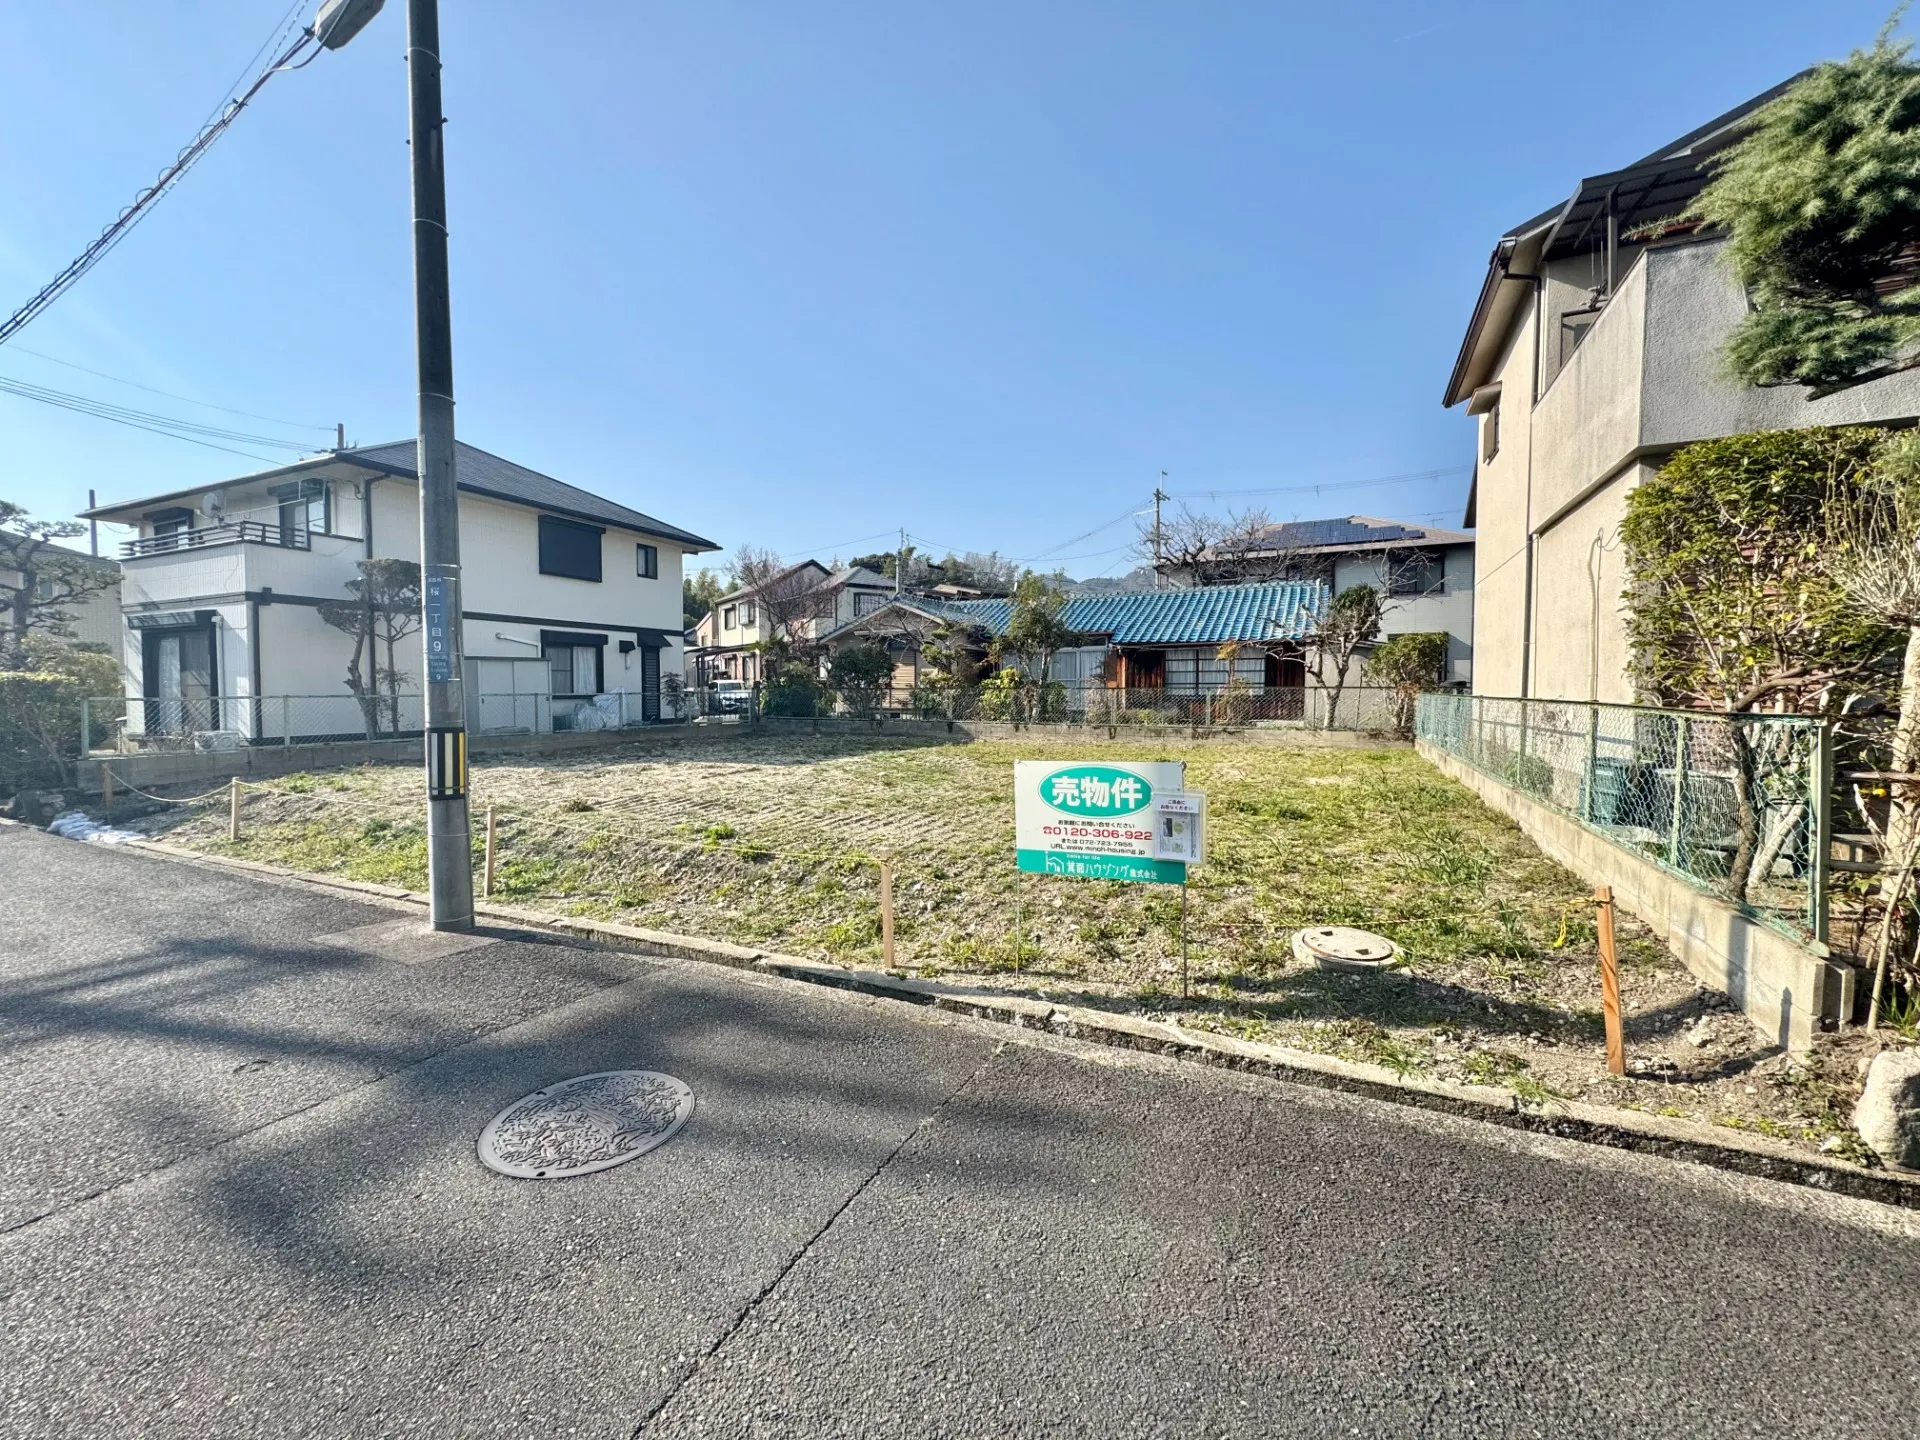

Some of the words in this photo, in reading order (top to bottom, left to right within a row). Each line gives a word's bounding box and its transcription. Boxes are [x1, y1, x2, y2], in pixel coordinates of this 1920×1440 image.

[1051, 776, 1143, 809] 売物件
[1053, 827, 1152, 840] 0120-306-922
